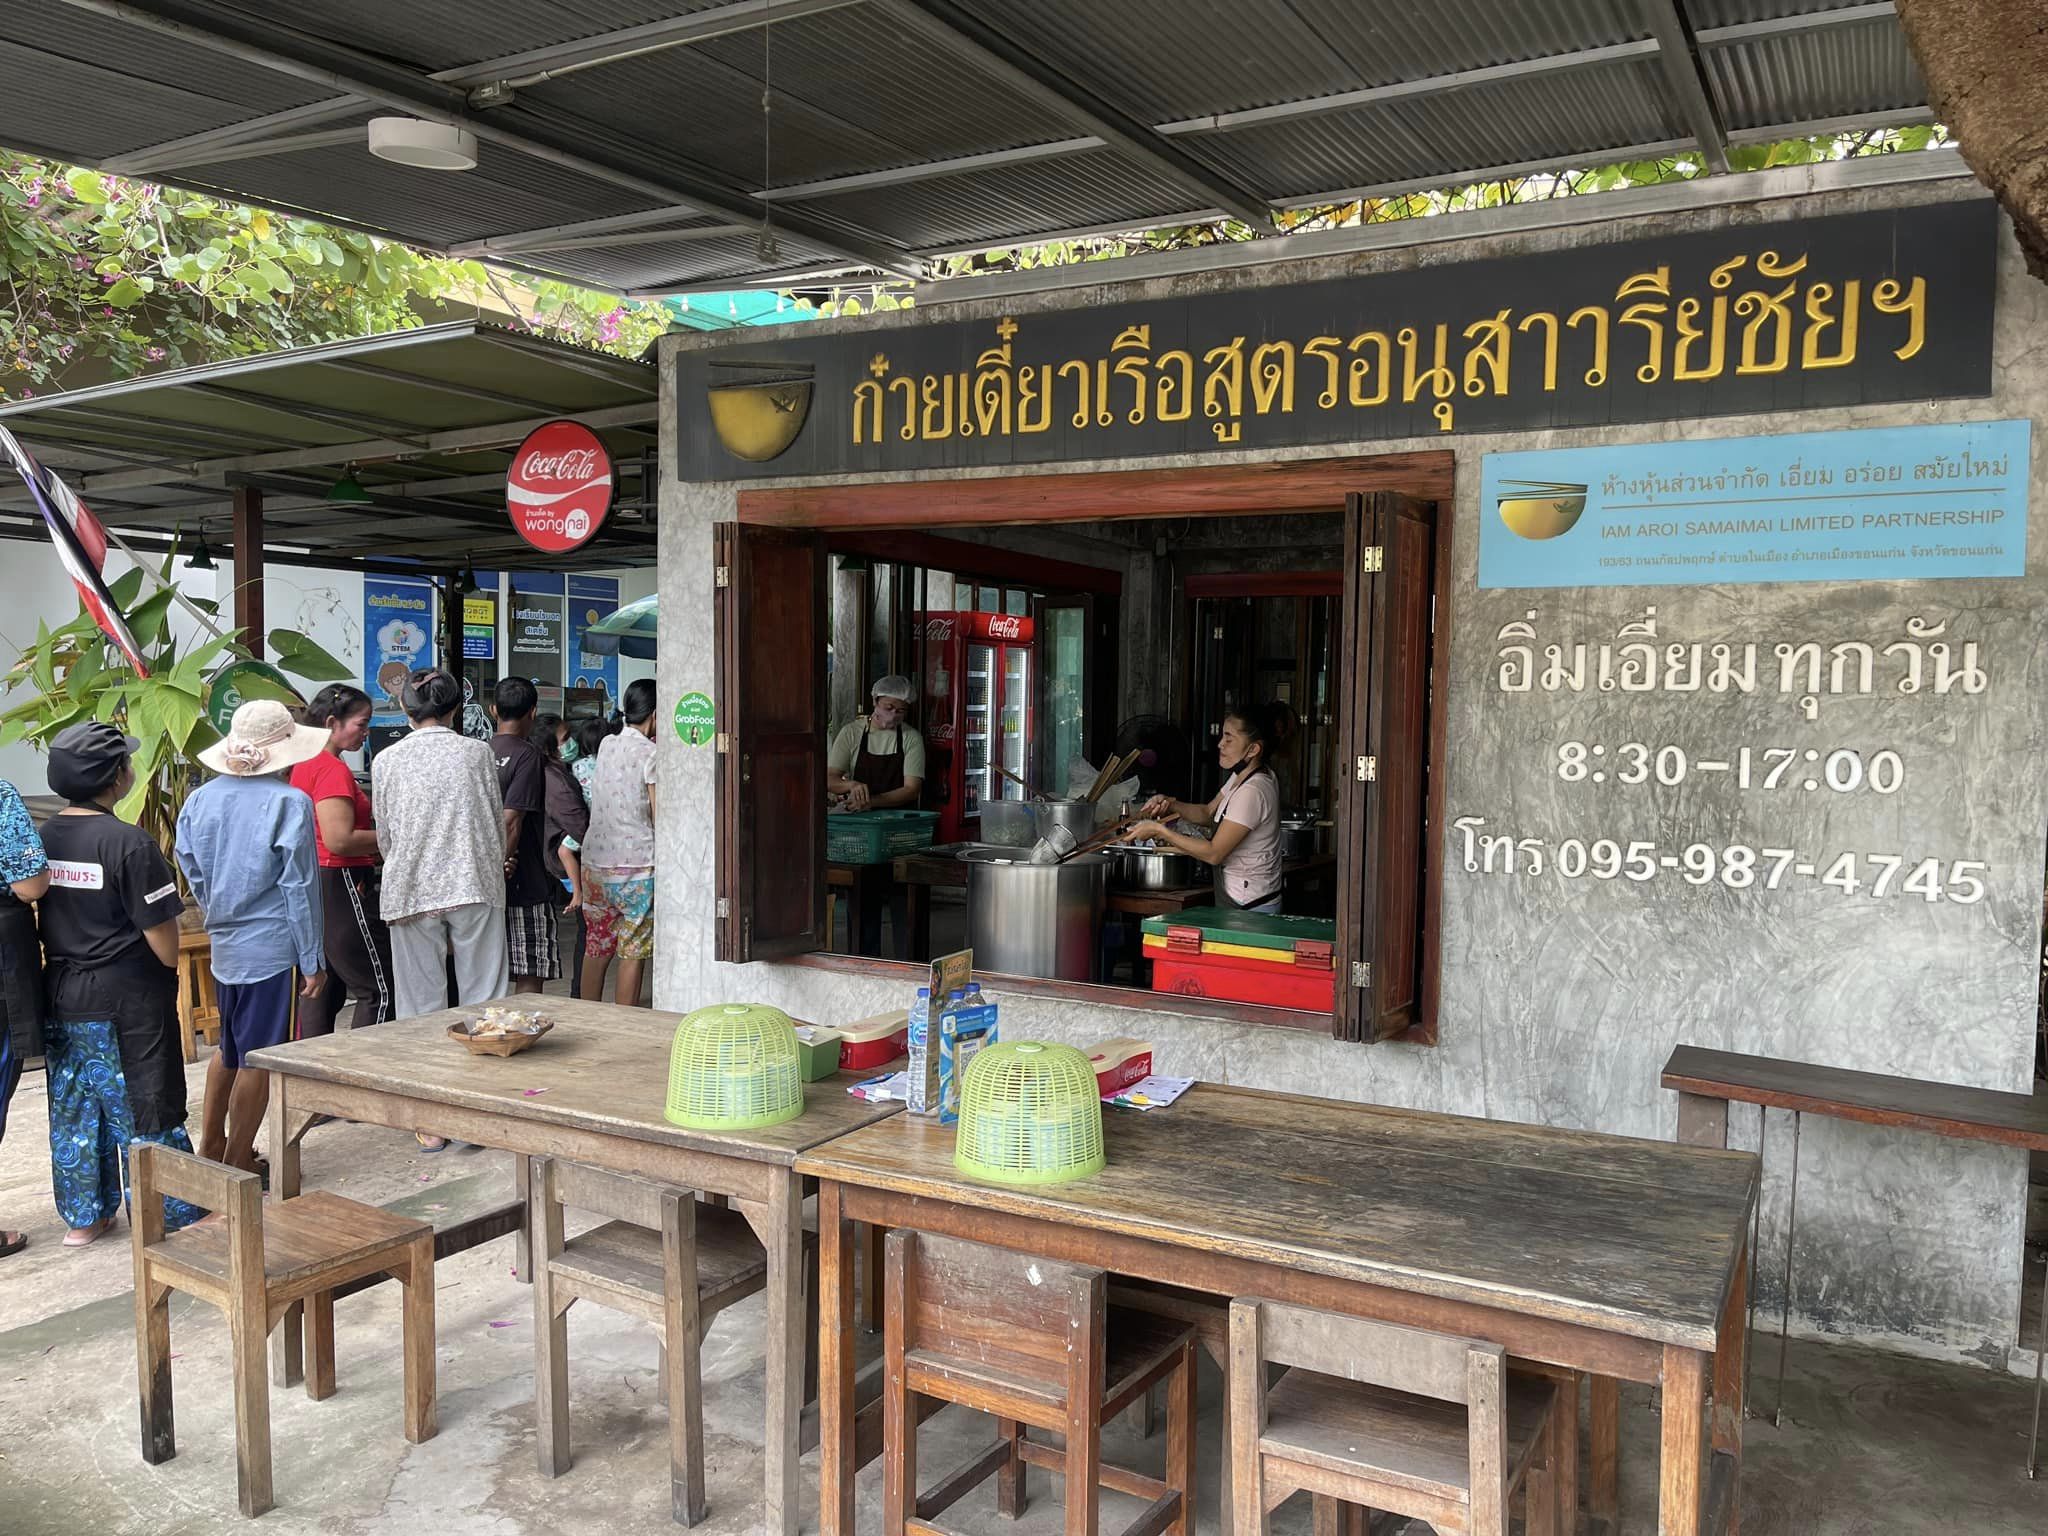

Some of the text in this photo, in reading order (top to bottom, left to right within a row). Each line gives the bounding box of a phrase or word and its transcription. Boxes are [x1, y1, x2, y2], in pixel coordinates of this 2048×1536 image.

[852, 250, 1926, 442] ก๋วยเตี๋ยวเรือสูตรอนุสาวรีย์ชัยฯ
[522, 449, 598, 480] Coca-Cola
[1601, 451, 2008, 502] ห้างหุ้นส่วนจำกัด เอี่ยม อร่อย สมัยใหม่
[1602, 509, 2005, 539] IAM AROI SAMAIMAI LIMITED PARTNERSHIP
[988, 615, 1020, 639] Coca-Cola
[1556, 839, 1987, 904] 095-987-4745
